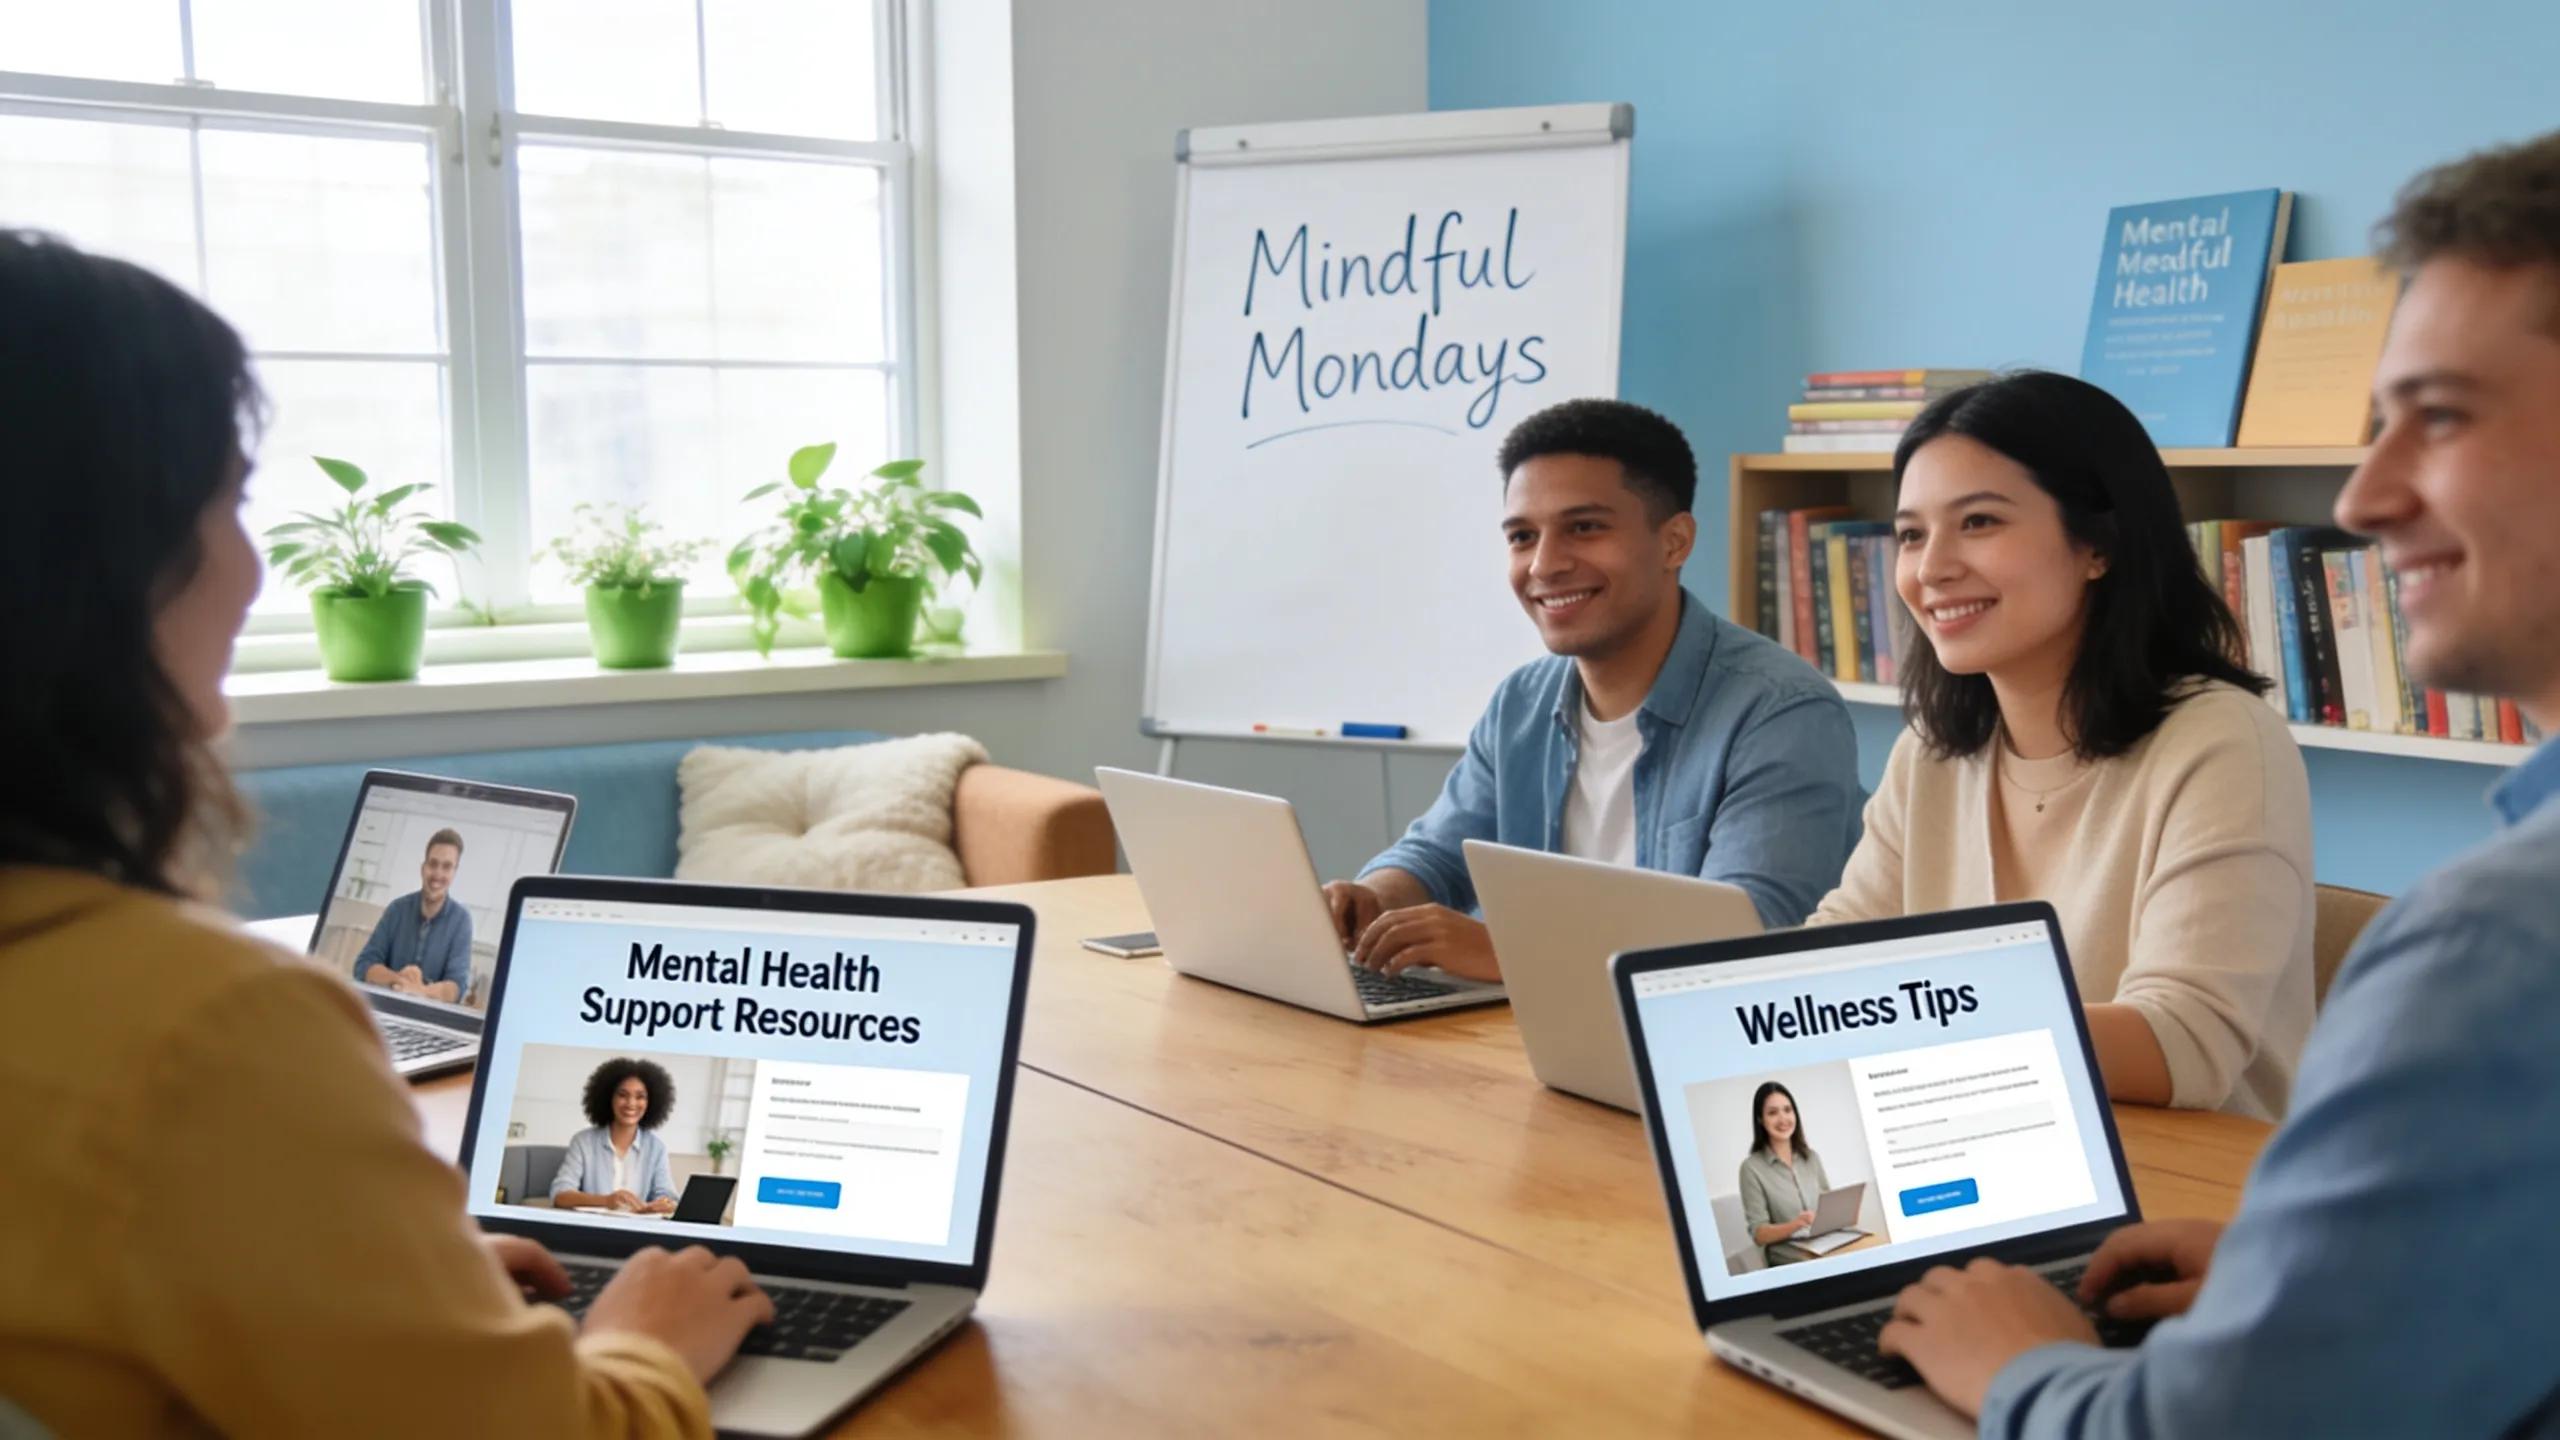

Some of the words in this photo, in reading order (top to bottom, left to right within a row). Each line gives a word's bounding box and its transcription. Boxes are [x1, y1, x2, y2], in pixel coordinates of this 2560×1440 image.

[2120, 205, 2230, 247] Mental
[1243, 207, 1537, 317] Mindful
[2112, 271, 2209, 309] Health
[1242, 312, 1548, 429] Mondays
[626, 942, 752, 985] Mental
[761, 950, 881, 993] Health
[580, 986, 725, 1037] Support
[734, 997, 922, 1045] Resources
[1735, 993, 1899, 1046] Wellness
[1898, 979, 1980, 1027] Tips
